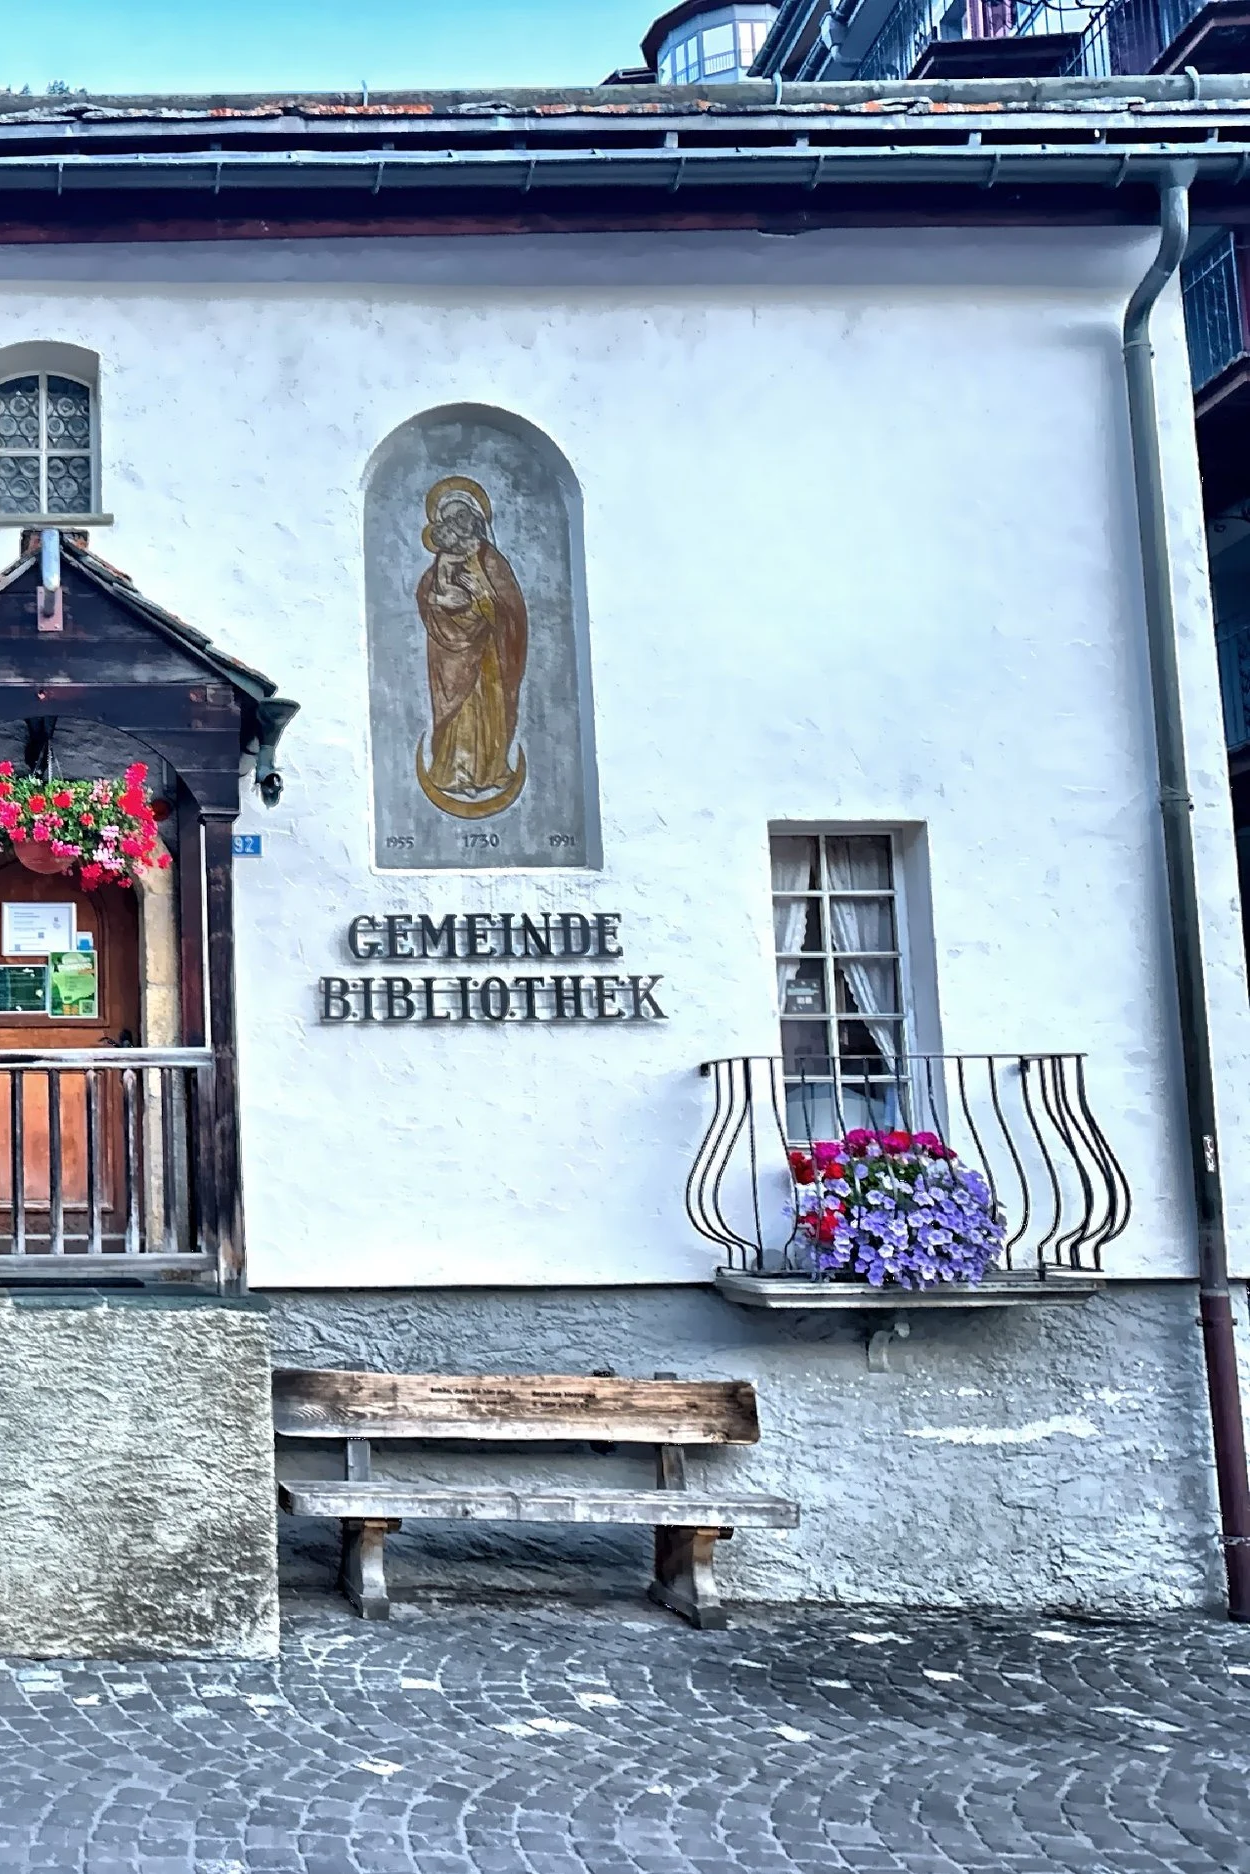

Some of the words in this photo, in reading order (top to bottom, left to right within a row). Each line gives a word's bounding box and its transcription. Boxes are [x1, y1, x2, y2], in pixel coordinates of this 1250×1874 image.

[234, 836, 254, 853] 92
[462, 834, 500, 848] 1730
[550, 835, 576, 847] 1991
[348, 912, 624, 959] GEMEINDE
[319, 974, 669, 1021] BIBLIOTHEK
